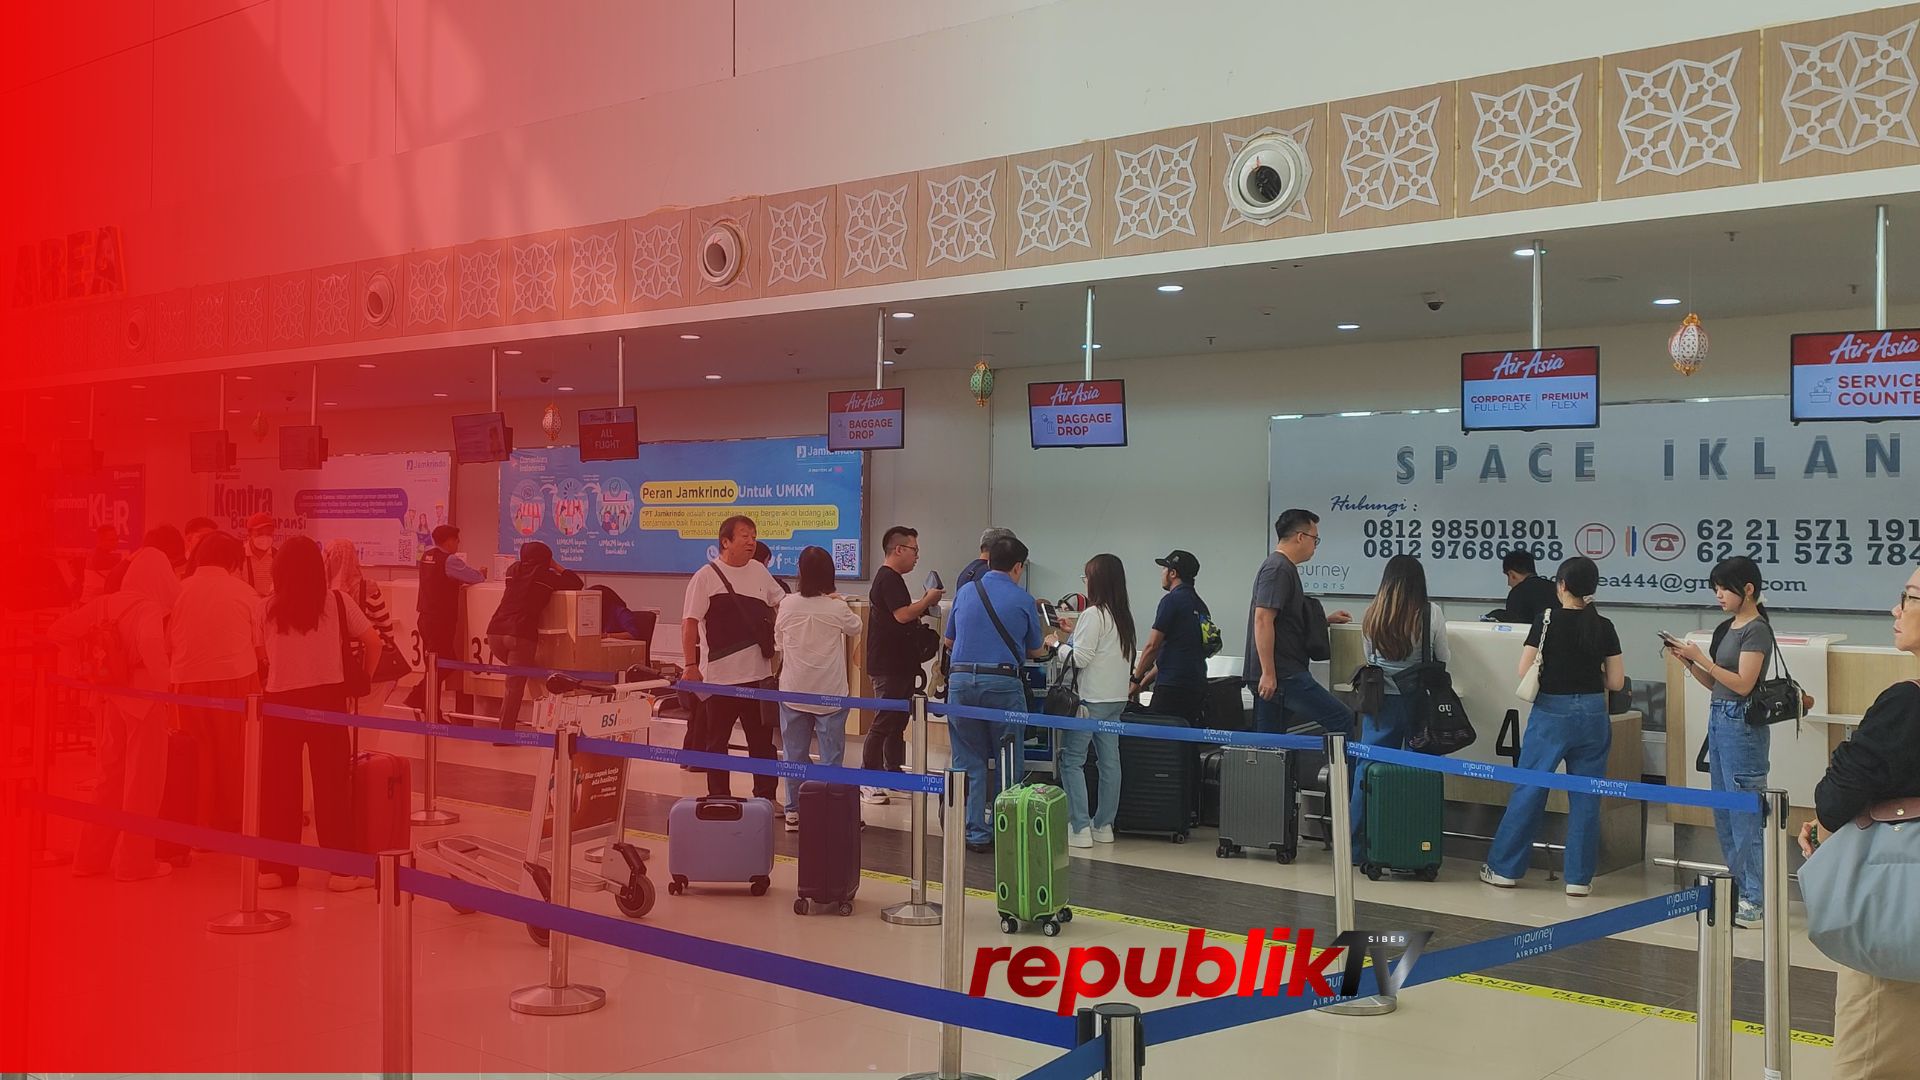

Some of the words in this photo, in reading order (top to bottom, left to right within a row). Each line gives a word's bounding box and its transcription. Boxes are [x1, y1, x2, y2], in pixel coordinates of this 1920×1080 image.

[1838, 373, 1920, 388] SERVICE
[1471, 394, 1532, 403] CORPORATE
[1542, 392, 1589, 401] PREMIUM
[1838, 390, 1920, 406] COUNTE
[1474, 403, 1499, 412] FULL
[1502, 402, 1527, 411] FLEX
[1551, 401, 1577, 410] FLEX
[849, 418, 893, 430] BAGGAGE
[1056, 413, 1112, 425] BAGGAGE
[601, 429, 614, 438] ALL
[849, 430, 874, 440] DROP
[1057, 426, 1089, 437] DROP
[595, 440, 621, 449] FLIGHT
[1396, 441, 1596, 485] SPACE
[1663, 432, 1900, 481] IKLAN
[642, 488, 672, 499] Peran
[676, 486, 735, 498] Jamkrindo
[738, 485, 772, 498] Untuk
[776, 484, 815, 497] UMKM
[214, 483, 273, 517] Kontra
[1330, 495, 1407, 517] Hubungi
[1363, 520, 1422, 539] 0812
[1431, 520, 1559, 540] 98501801
[1697, 519, 1733, 540] 62
[1746, 519, 1780, 541] 21
[1794, 519, 1850, 541] 571
[1363, 540, 1422, 559] 0812
[1697, 541, 1733, 563] 62
[1746, 542, 1780, 564] 21
[1794, 543, 1853, 565] 573
[1297, 564, 1350, 581] ourney
[601, 713, 618, 728] BSI
[921, 776, 944, 786] injour
[1516, 944, 1553, 959] AIRPORTS
